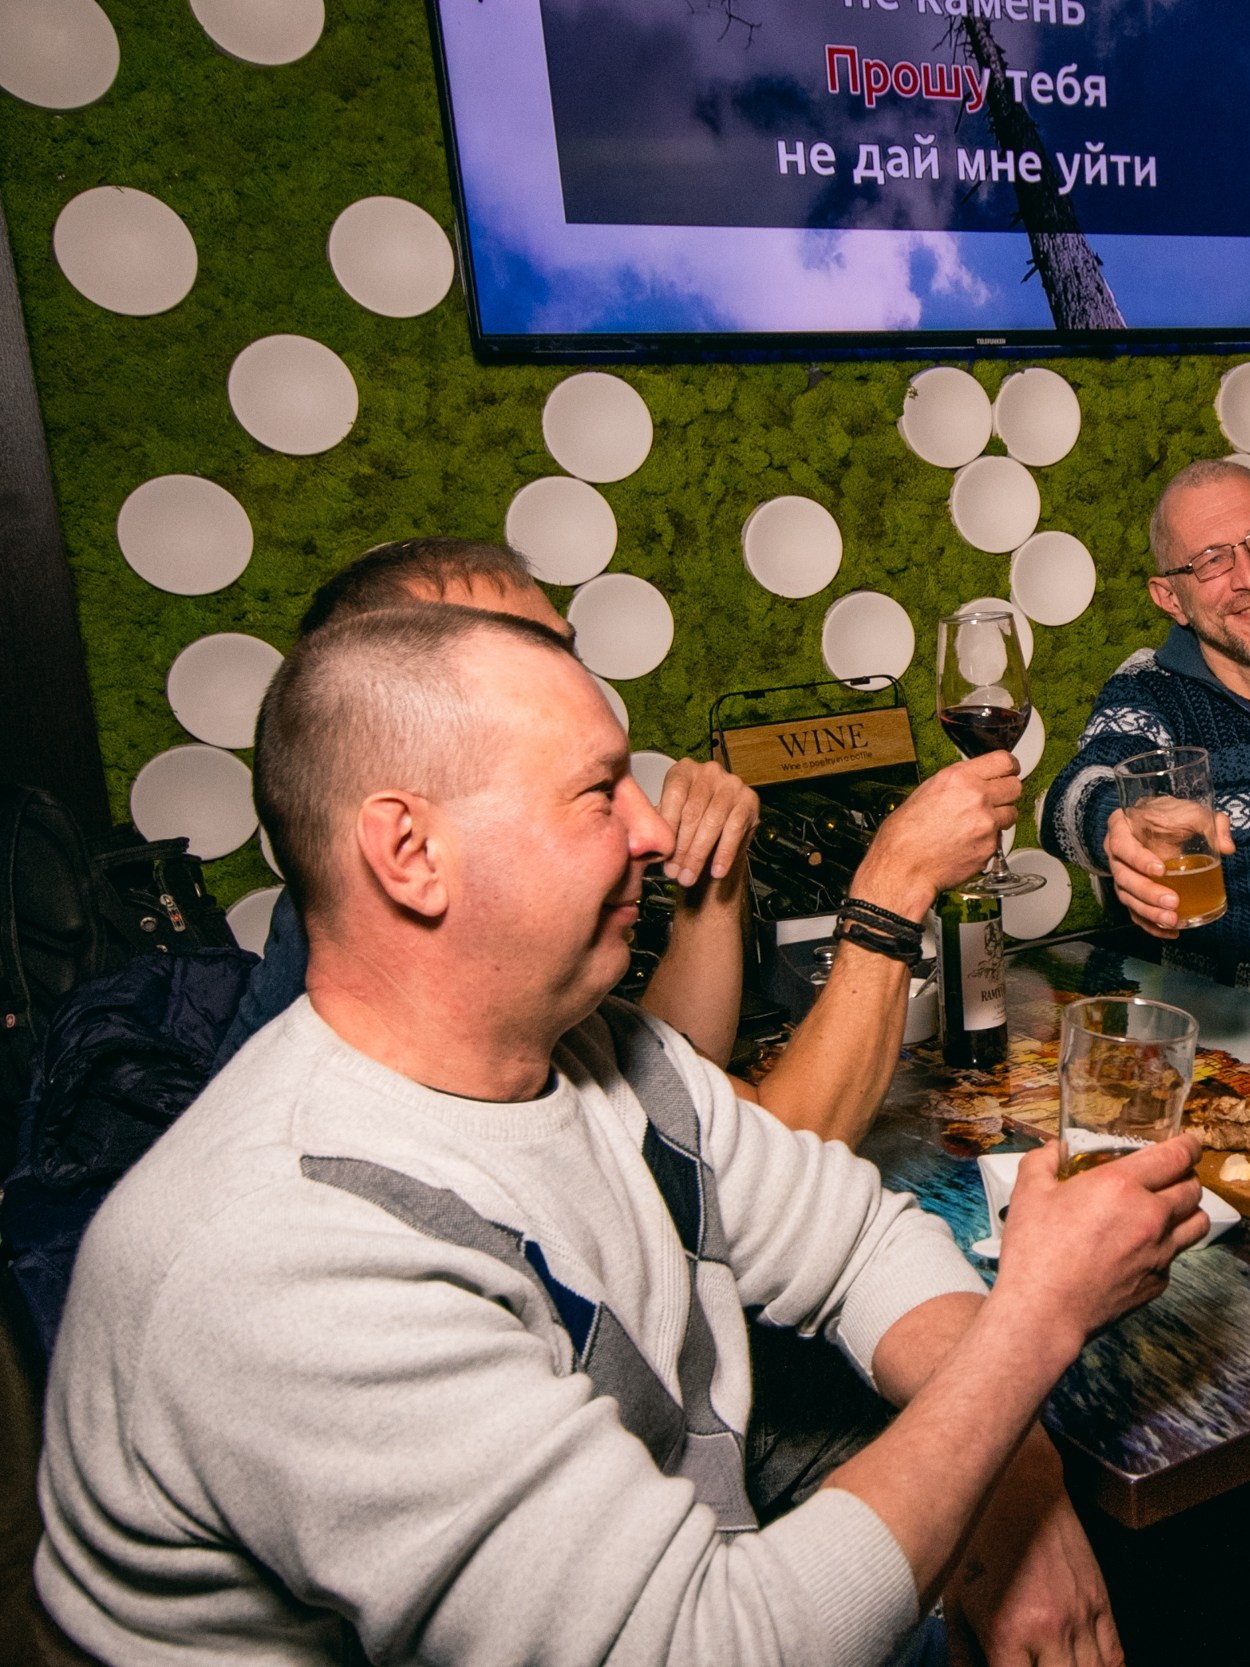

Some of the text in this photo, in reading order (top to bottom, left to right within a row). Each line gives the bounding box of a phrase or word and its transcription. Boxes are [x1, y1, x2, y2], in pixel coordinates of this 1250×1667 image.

[825, 44, 1107, 113] Прошу тебя
[777, 133, 1157, 195] не дай мне уйти
[776, 723, 869, 758] WINE
[780, 762, 803, 772] Wine
